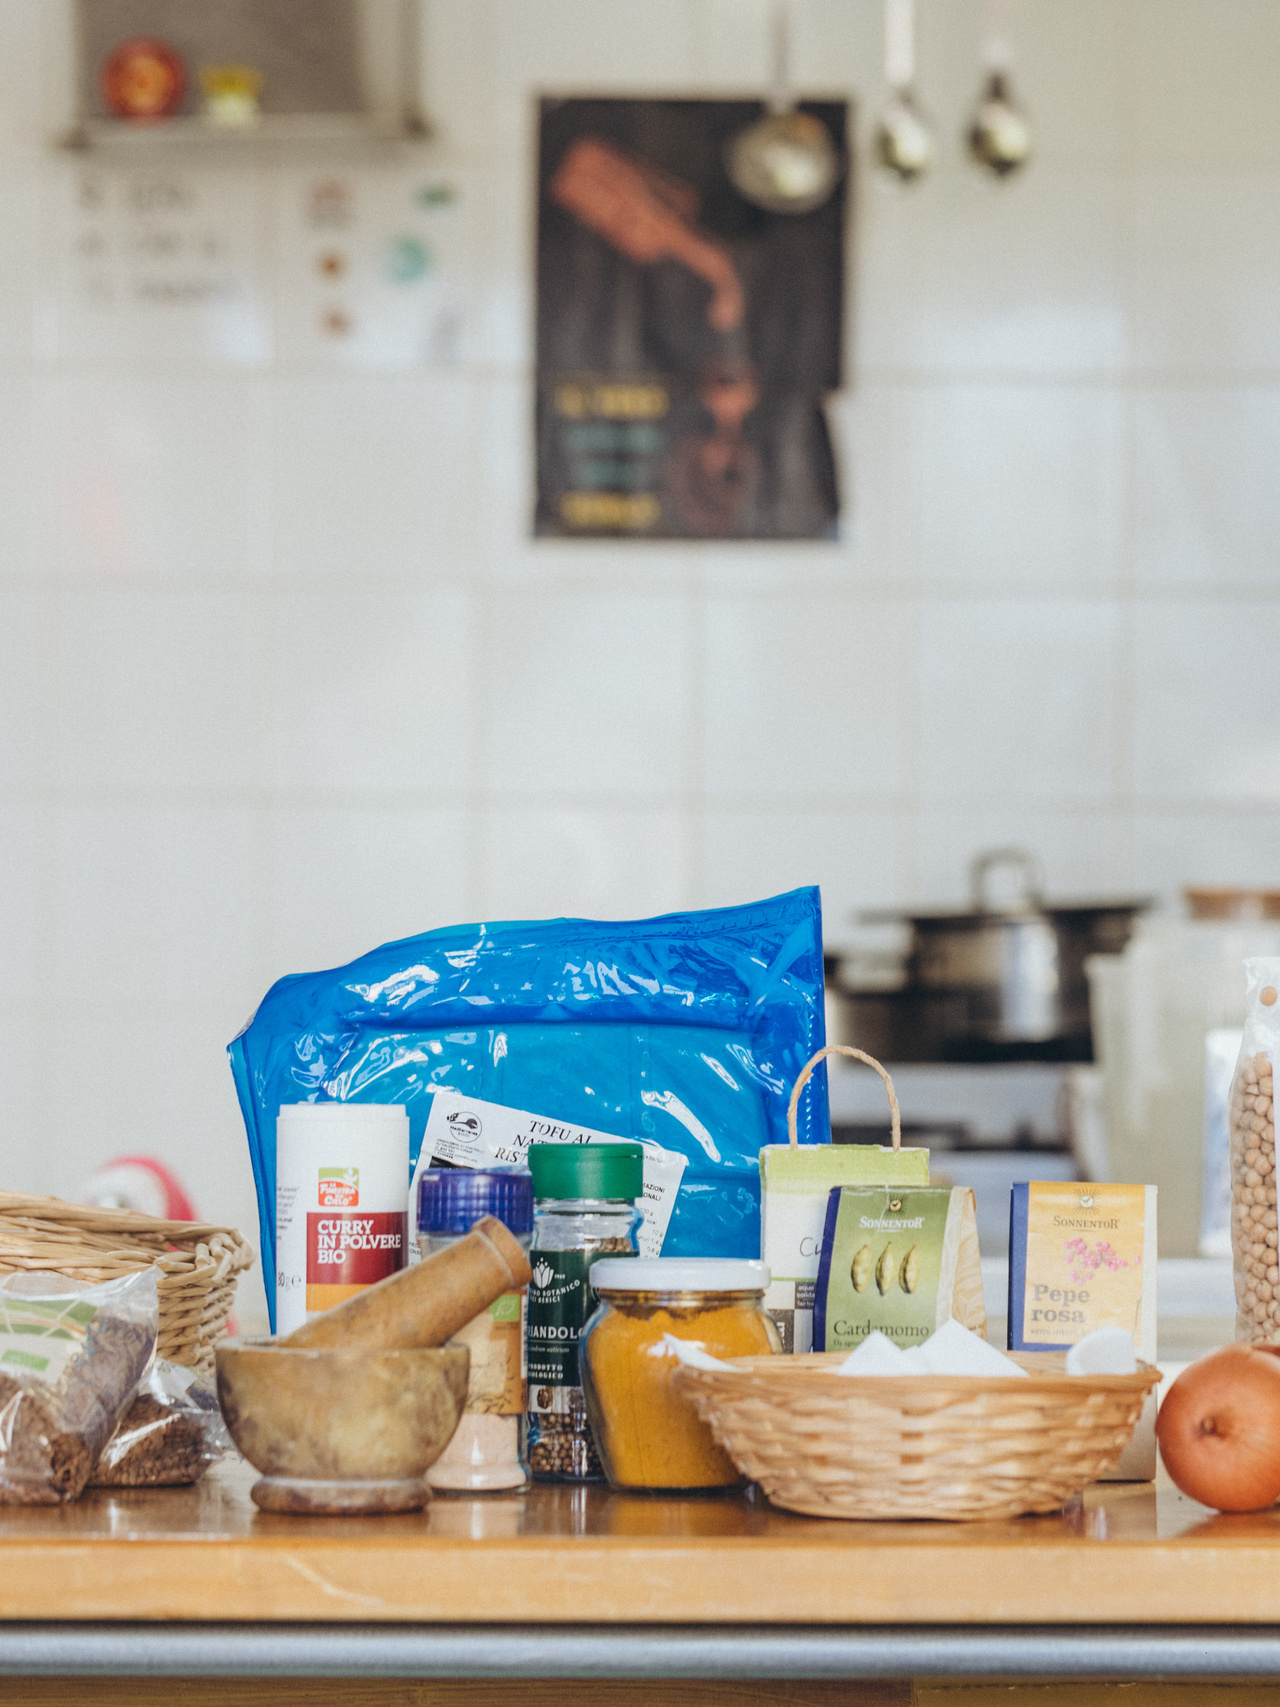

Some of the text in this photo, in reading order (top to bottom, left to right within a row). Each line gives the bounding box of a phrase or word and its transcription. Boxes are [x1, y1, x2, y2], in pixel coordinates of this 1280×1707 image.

[529, 1120, 572, 1141] TOFU
[317, 1220, 374, 1235] CURRY
[1053, 1215, 1119, 1230] SONNENTOR
[317, 1234, 337, 1249] IN
[340, 1234, 401, 1249] POLVERE
[317, 1249, 347, 1264] BIO
[542, 1279, 581, 1297] BOTANICO
[1032, 1283, 1090, 1307] Pepe
[1031, 1307, 1086, 1323] rosa
